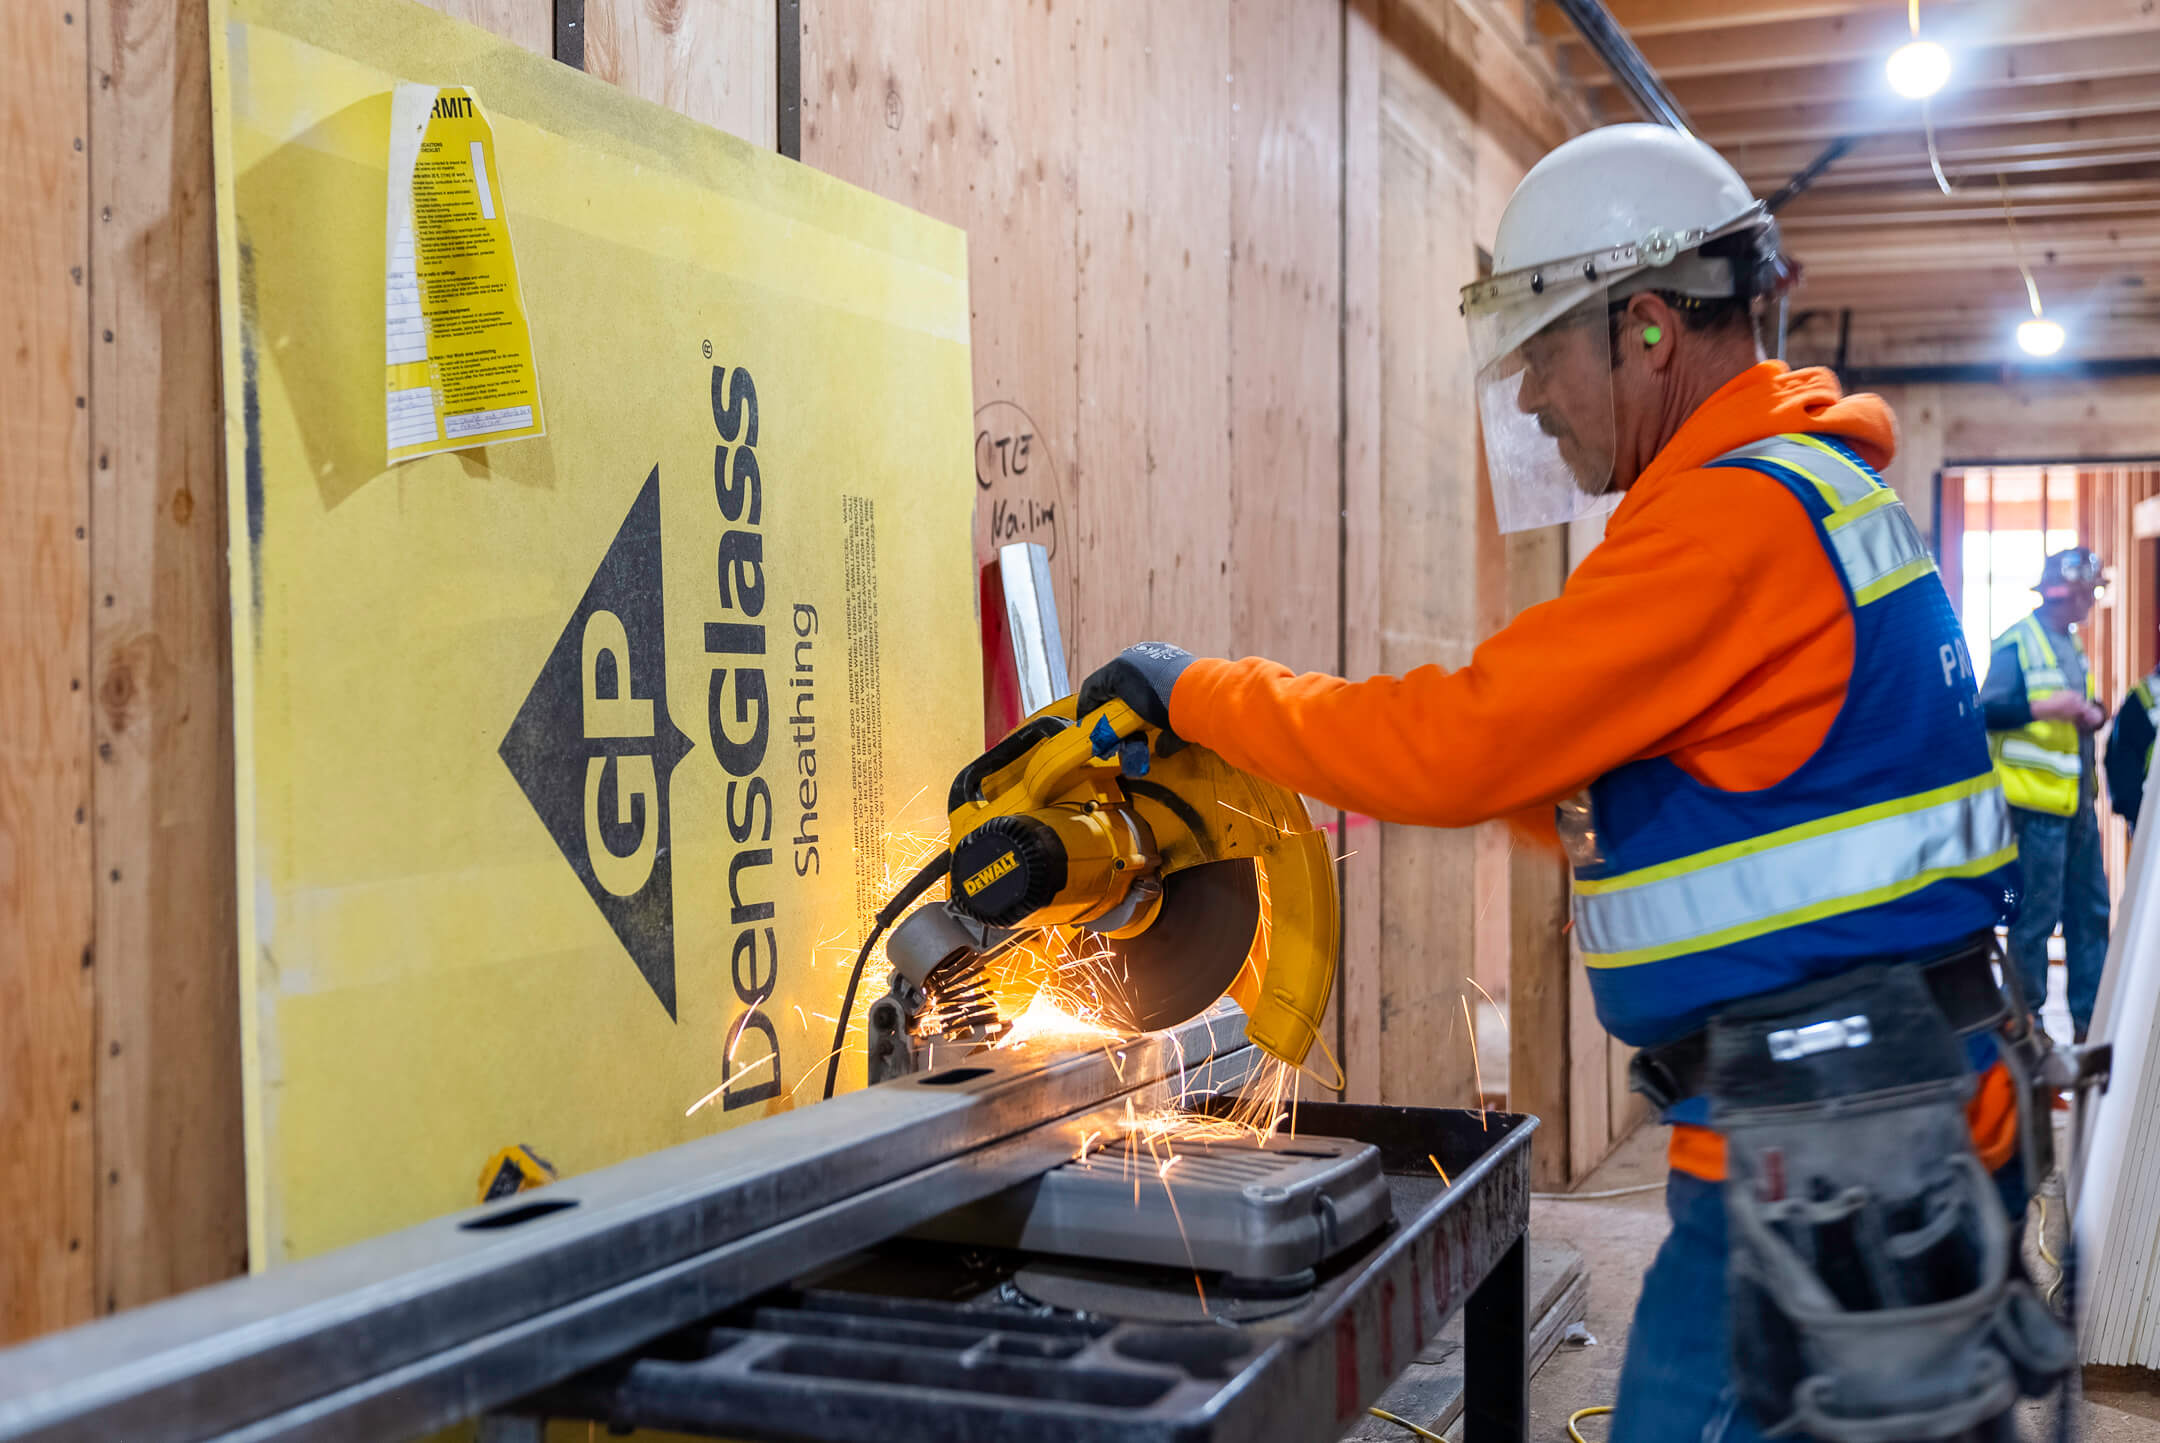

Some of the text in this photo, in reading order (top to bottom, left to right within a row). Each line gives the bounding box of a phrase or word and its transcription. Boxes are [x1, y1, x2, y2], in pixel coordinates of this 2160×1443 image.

[582, 609, 659, 897] GP
[704, 365, 782, 1112] DensGlass
[789, 602, 820, 877] Sheathing
[964, 851, 1018, 896] DEWALT
